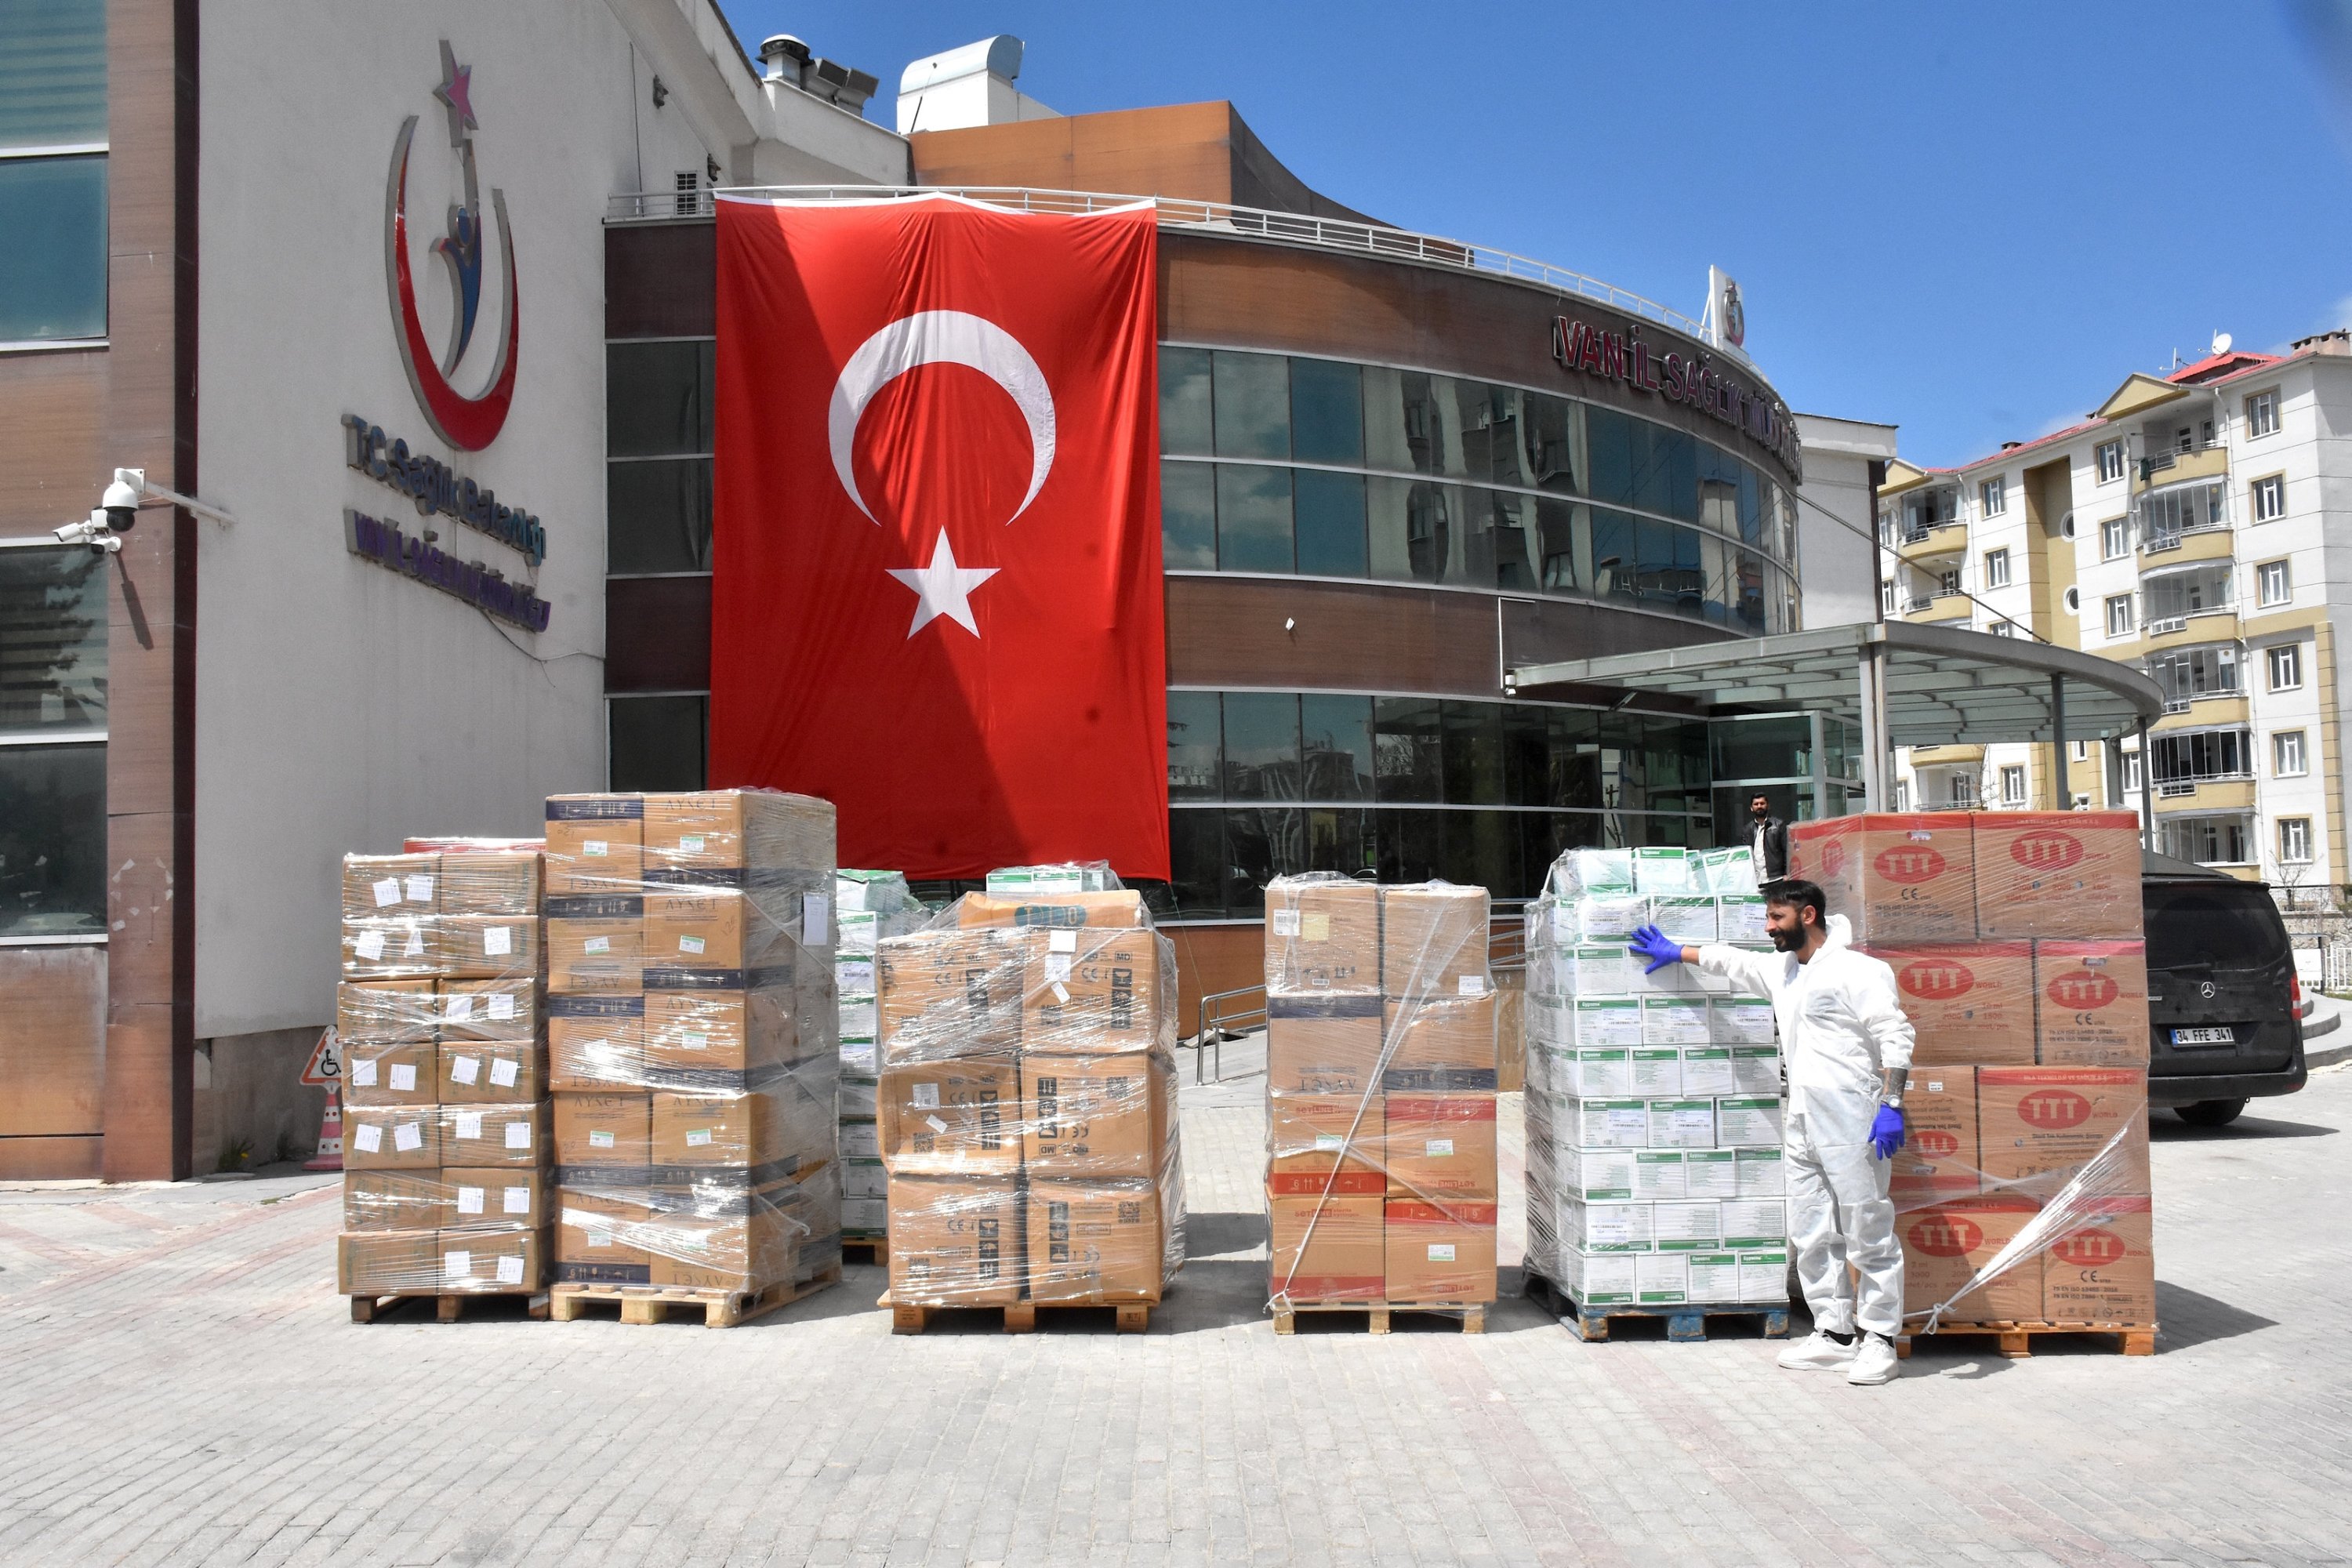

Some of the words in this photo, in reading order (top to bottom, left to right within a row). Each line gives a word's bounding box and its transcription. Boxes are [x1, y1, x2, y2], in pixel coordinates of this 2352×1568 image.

[1554, 316, 1624, 381] VAN
[1632, 325, 1658, 391] İL
[1663, 351, 1746, 430] SAĞLIK
[2022, 840, 2070, 861] TTT
[1885, 853, 1933, 874] TTT
[1901, 887, 1918, 900] CE
[1910, 968, 1961, 989] TTT
[2058, 980, 2106, 1000] TTT
[2075, 1013, 2092, 1025] CE
[2176, 1030, 2188, 1042] 34
[2193, 1029, 2210, 1041] FFE
[2215, 1029, 2232, 1040] 341
[2029, 1098, 2078, 1120] TTT
[1918, 1138, 1951, 1154] TTT
[1919, 1224, 1969, 1247] TTT
[2064, 1236, 2112, 1256] TTT
[2080, 1270, 2098, 1283] CE
